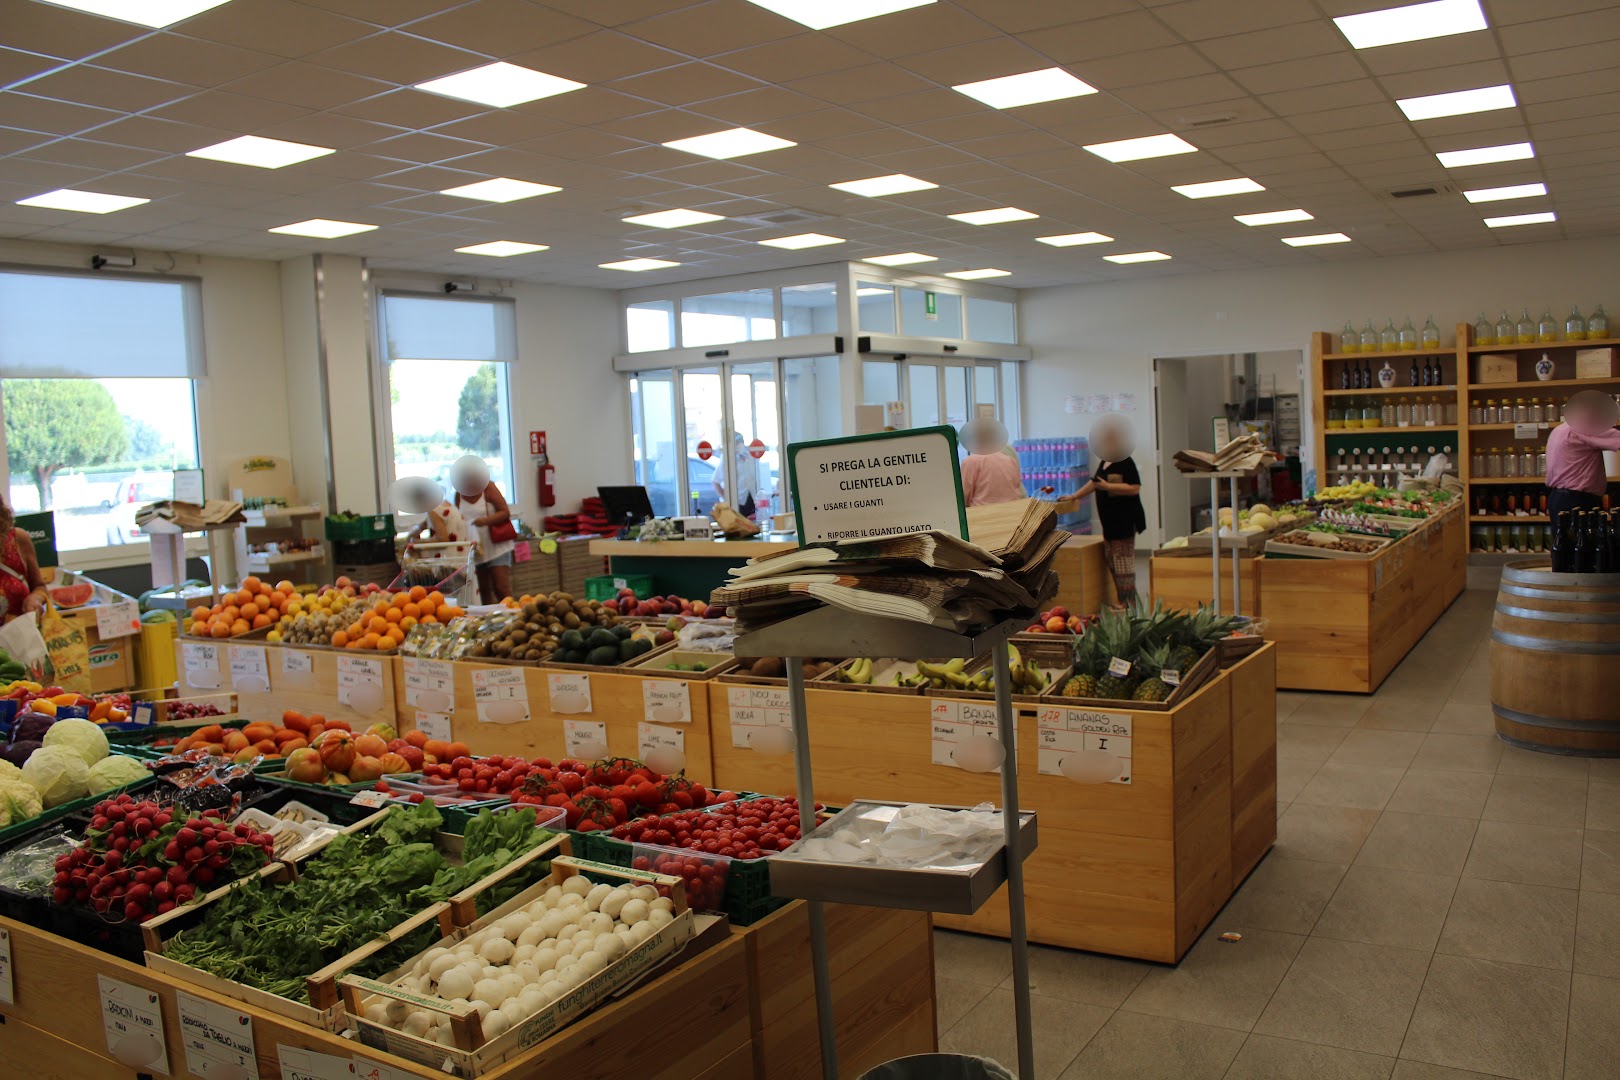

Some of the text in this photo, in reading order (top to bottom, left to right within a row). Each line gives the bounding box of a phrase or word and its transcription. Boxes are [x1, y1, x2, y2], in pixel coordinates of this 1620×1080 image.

[819, 452, 927, 473] SI PREGA LA GENTILE
[839, 475, 911, 491] CLIENTELA DI:
[823, 498, 884, 511] USARE I GUANTI
[827, 524, 932, 540] RIPORRE IL GUANTO USATO
[752, 690, 769, 698] NOCI
[766, 699, 790, 707] COCC
[735, 710, 754, 719] INDIA
[963, 706, 997, 720] BANAN
[1041, 710, 1110, 725] 178 ANANAS
[1081, 724, 1110, 733] GOLDEN
[558, 934, 664, 1014] funghiterreromagna.it
